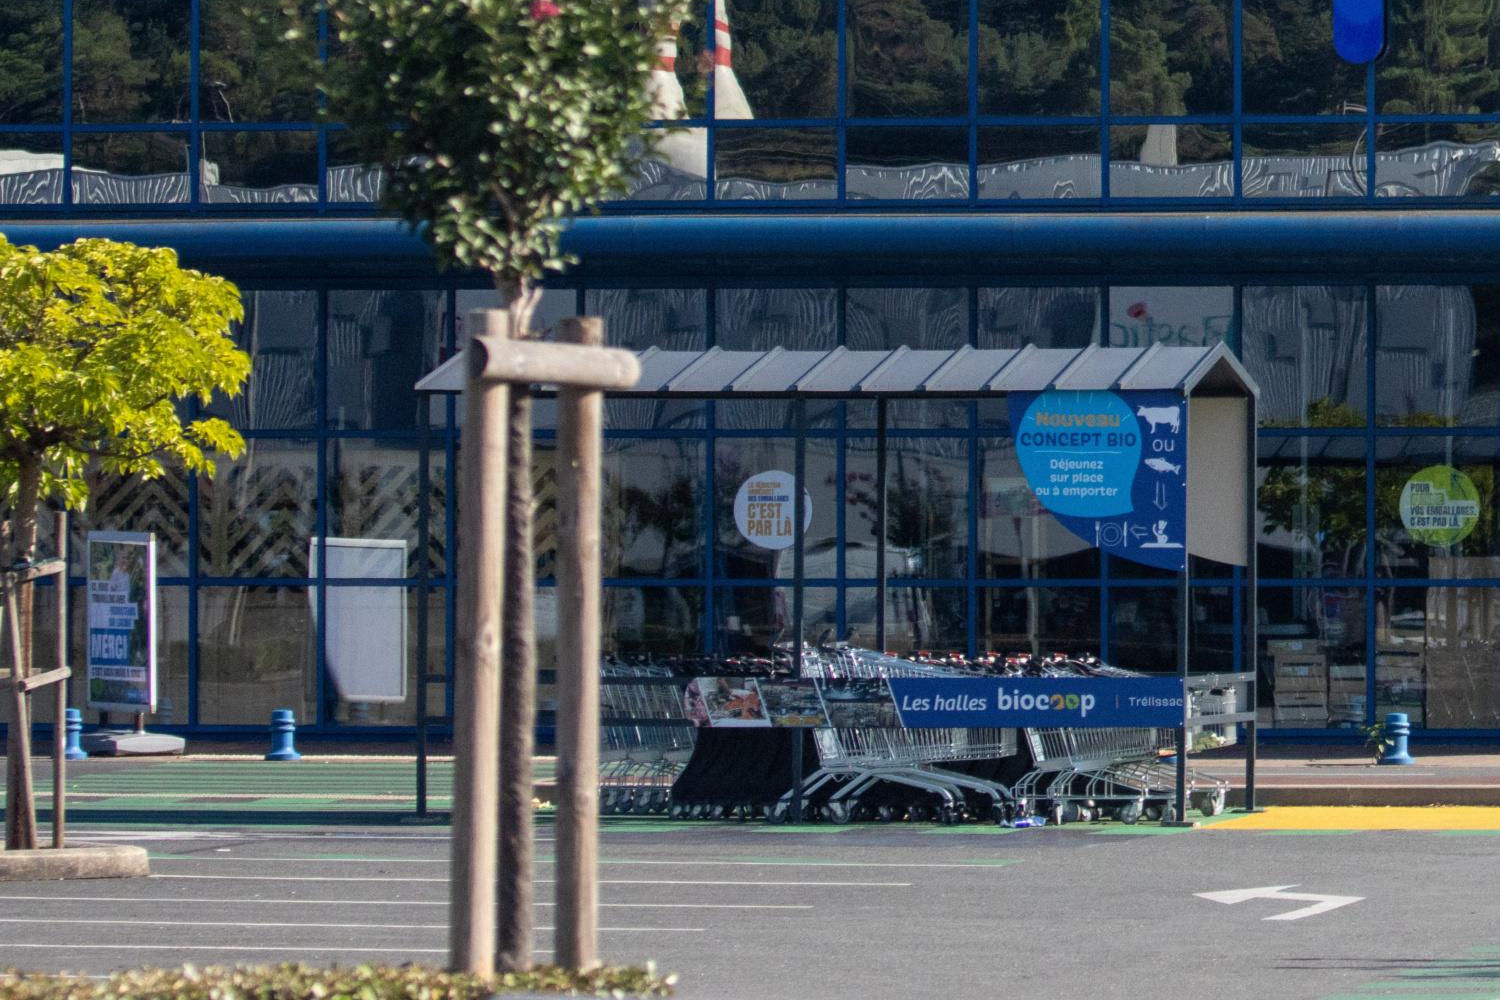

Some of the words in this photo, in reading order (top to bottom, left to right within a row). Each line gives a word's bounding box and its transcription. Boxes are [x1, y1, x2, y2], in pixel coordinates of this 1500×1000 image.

[1036, 411, 1120, 427] Nouveau
[1020, 432, 1102, 447] CONCEPT
[1107, 432, 1137, 447] BIO
[1050, 458, 1104, 471] Déjeunez
[1050, 475, 1069, 483] sur
[1072, 473, 1104, 484] place
[1036, 488, 1050, 496] ou
[1053, 486, 1060, 496] à
[1063, 487, 1118, 498] emporter
[748, 503, 782, 519] C'EST
[747, 519, 772, 536] PAR
[776, 516, 792, 536] LÀ
[91, 633, 128, 660] MERCI
[903, 695, 929, 711] Les
[933, 695, 987, 711] halles
[998, 687, 1095, 717] biocoop
[1128, 696, 1184, 707] Trélissac
